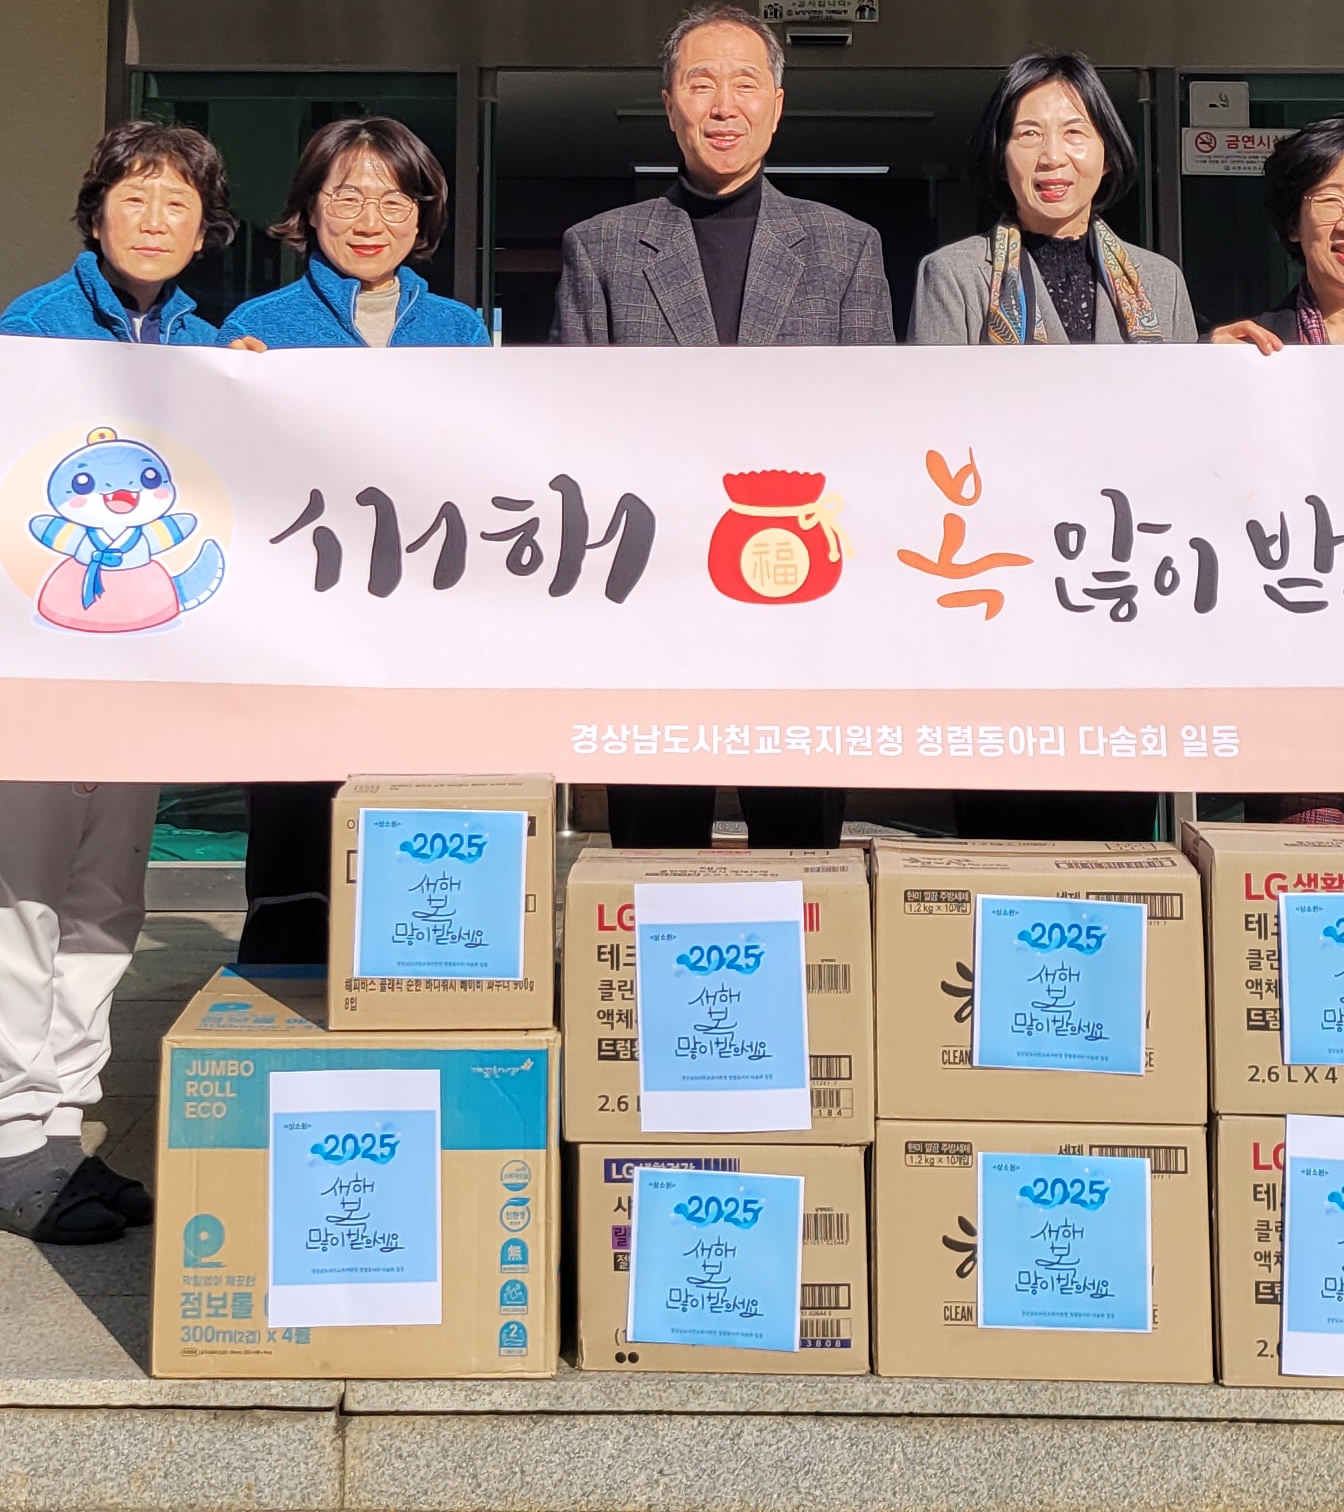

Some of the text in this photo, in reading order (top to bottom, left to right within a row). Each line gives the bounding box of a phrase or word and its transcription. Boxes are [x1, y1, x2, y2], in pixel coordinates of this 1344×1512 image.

[269, 473, 657, 604] 새해
[1054, 489, 1219, 623] 많이
[752, 542, 799, 588] 福
[570, 723, 1242, 758] 경상남도사천교육지원청 청렴동아리 다솜회 일동
[412, 832, 488, 863] 2025
[408, 870, 462, 894] 새해
[597, 903, 635, 932] LG
[1244, 912, 1280, 941] 테
[1031, 922, 1106, 954] 2025
[687, 945, 765, 975] 2025
[1027, 960, 1081, 984] 새해
[598, 979, 635, 1002] 클린
[688, 982, 742, 1006] 새해
[596, 1008, 638, 1031] 액체
[185, 1059, 255, 1077] JUMBO
[941, 1048, 971, 1066] CLEAN
[1247, 1065, 1281, 1084] 2.6
[1324, 1066, 1339, 1084] 4
[185, 1080, 237, 1098] ROLL
[185, 1102, 227, 1120] ECO
[597, 1094, 630, 1113] 2.6
[323, 1132, 400, 1164] 2025
[320, 1172, 375, 1197] 새해
[1032, 1177, 1110, 1209] 2025
[687, 1194, 765, 1228] 2025
[1029, 1216, 1084, 1240] 새해
[683, 1235, 737, 1259] 새해
[180, 1291, 254, 1320] 점보롤
[943, 1304, 974, 1322] CLEAN
[800, 1339, 842, 1348] 3808
[1256, 1339, 1282, 1359] 2.
